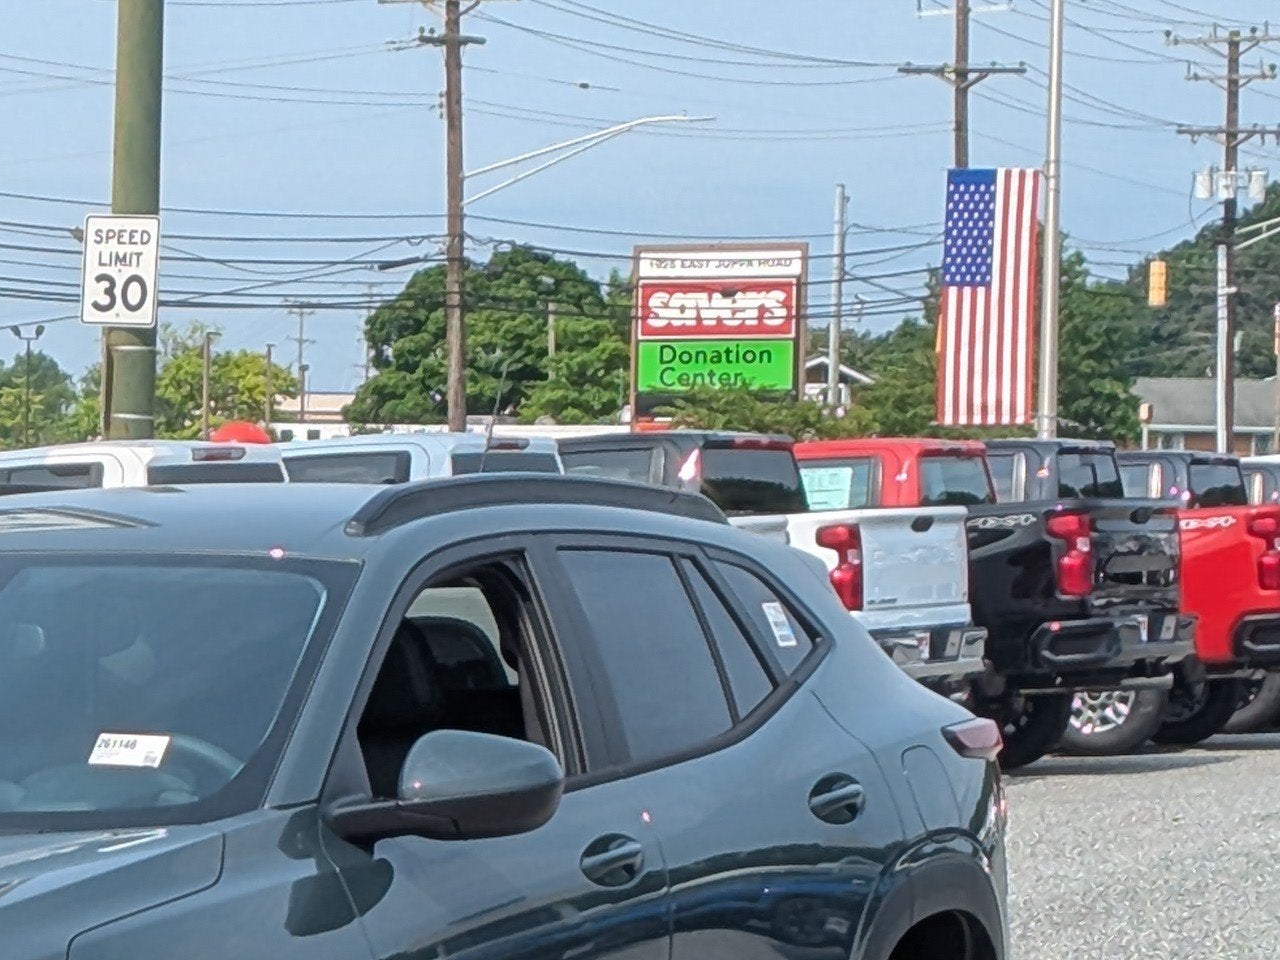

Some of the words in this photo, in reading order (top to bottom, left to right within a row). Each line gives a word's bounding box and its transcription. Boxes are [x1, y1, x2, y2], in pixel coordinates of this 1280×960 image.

[93, 229, 151, 245] SPEED
[98, 251, 143, 267] LIMIT
[680, 258, 711, 269] EAST
[757, 257, 793, 268] ROAD
[91, 273, 148, 313] 30
[659, 343, 773, 365] Donation
[659, 367, 744, 387] Center
